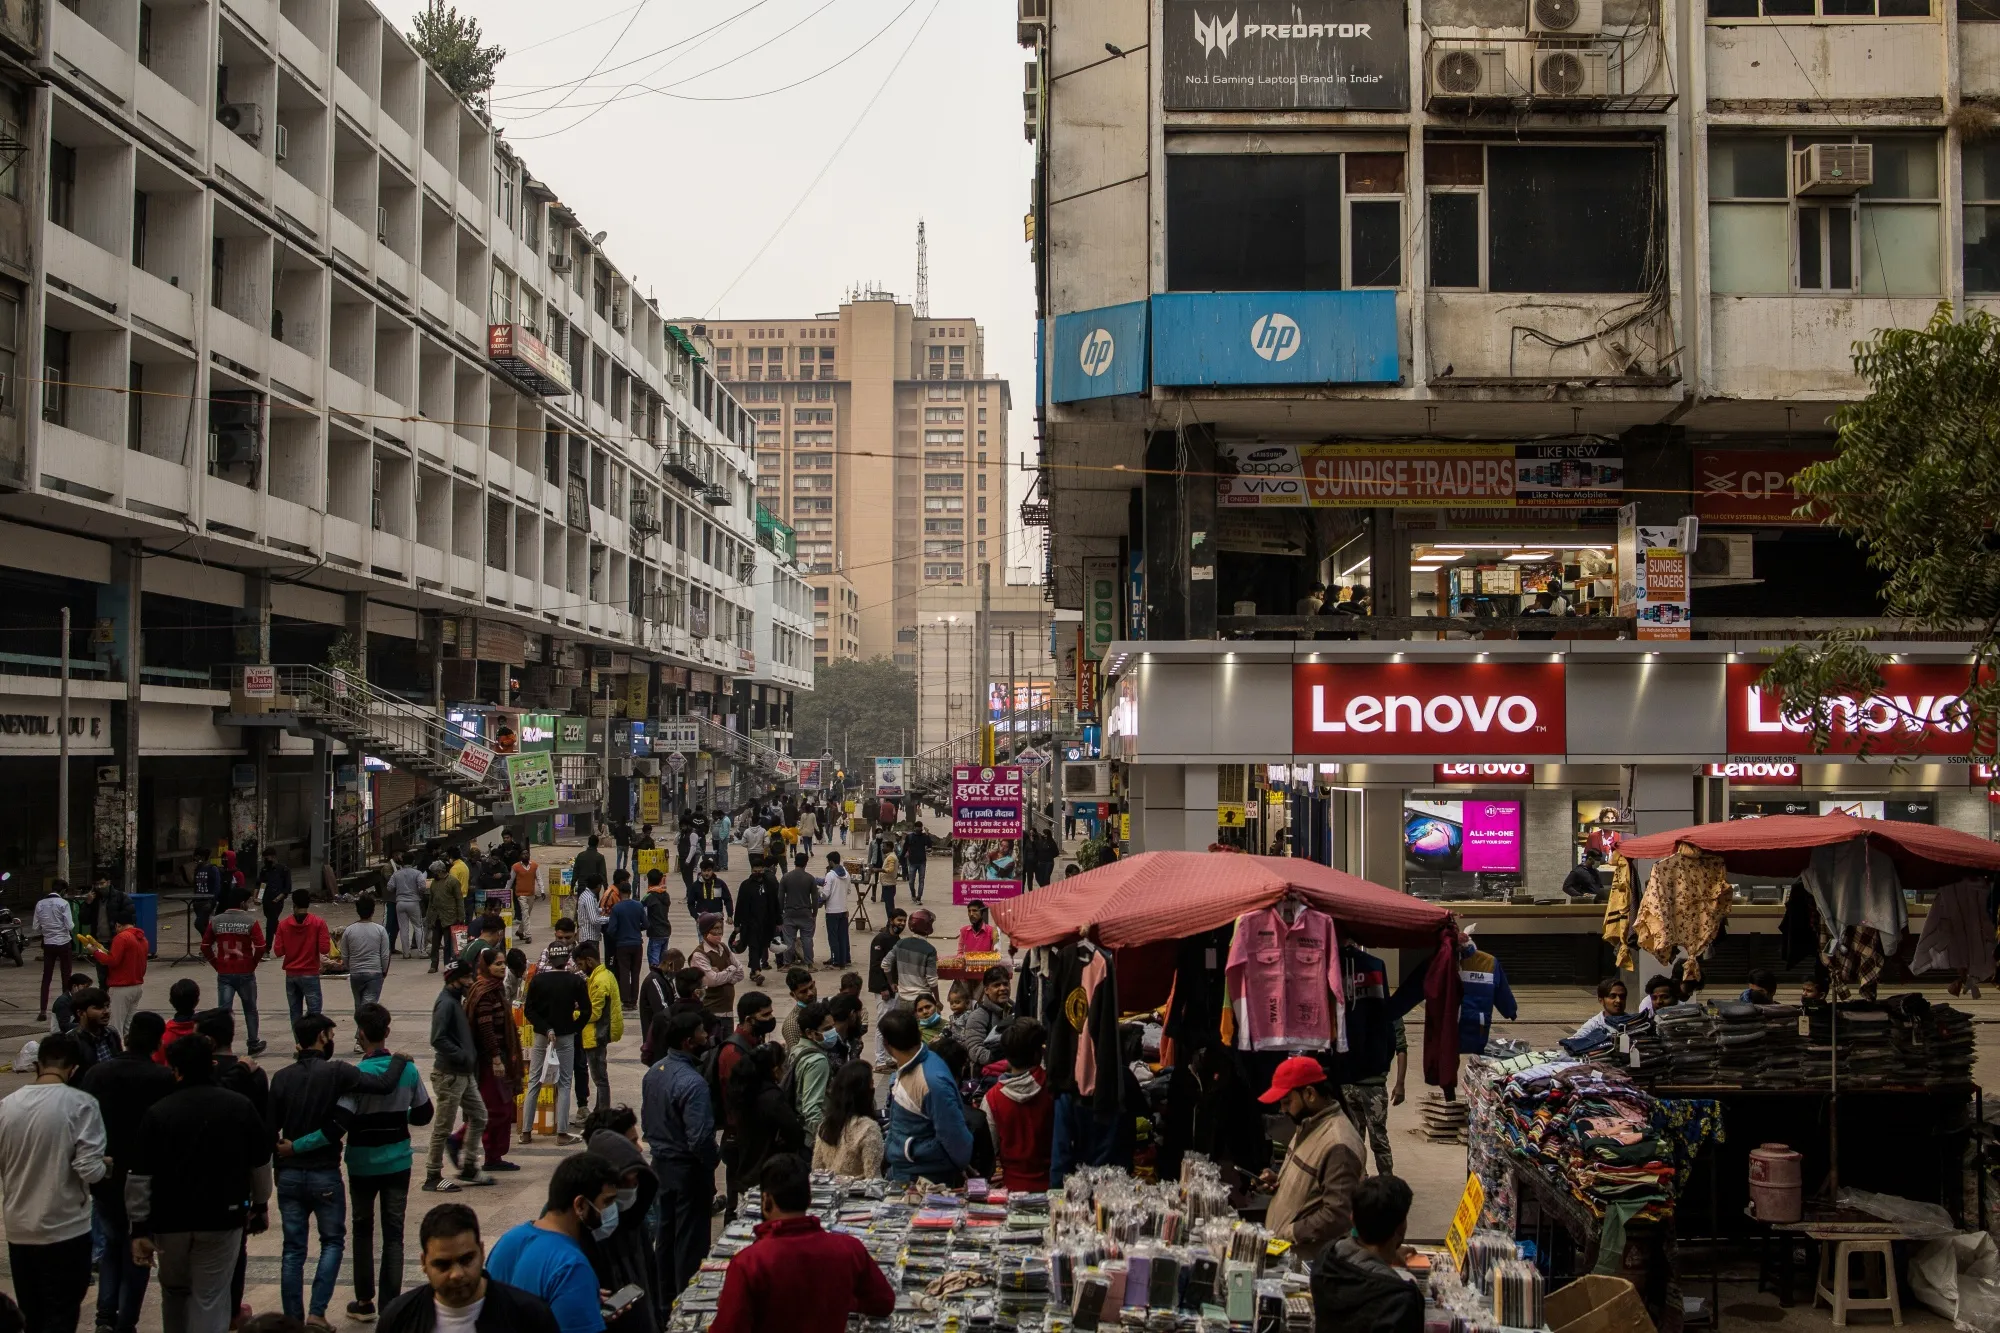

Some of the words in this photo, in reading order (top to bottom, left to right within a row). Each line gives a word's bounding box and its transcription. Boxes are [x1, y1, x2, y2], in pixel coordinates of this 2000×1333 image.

[1244, 23, 1373, 42] PREDATOR
[1186, 75, 1209, 84] No.1
[1213, 75, 1254, 87] Gaming
[1258, 75, 1297, 87] Laptop
[1300, 74, 1334, 85] Brand
[1337, 74, 1347, 85] in
[493, 326, 510, 337] AV
[1252, 313, 1300, 361] hp
[1081, 329, 1114, 376] hp
[1251, 450, 1283, 460] SAMSUNG
[1537, 447, 1562, 458] LIKE
[1564, 446, 1600, 458] NEW
[1315, 459, 1408, 496] SUNRISE
[1411, 458, 1513, 496] TRADERS
[1243, 478, 1298, 492] vivo
[1265, 495, 1298, 503] realme
[1531, 491, 1548, 499] Like
[1551, 491, 1570, 499] New
[1573, 491, 1608, 499] Mobiles
[1719, 513, 1736, 521] CCTV
[1735, 513, 1762, 521] SYSTEMS
[1649, 559, 1683, 573] SUNRISE
[1647, 574, 1685, 588] TRADERS
[249, 668, 270, 676] Xpert
[252, 676, 272, 684] Data
[1312, 685, 1537, 733] Lenovo
[1746, 684, 1973, 734] Lenovo
[468, 745, 489, 759] Xpert
[1068, 749, 1080, 761] hp
[461, 758, 485, 773] Recovery
[467, 755, 487, 769] Data
[1443, 763, 1525, 775] Lenovo
[1712, 763, 1795, 777] Lenovo
[955, 783, 991, 801] हुनर
[994, 783, 1020, 797] हाट
[974, 808, 994, 818] प्रगति
[994, 808, 1015, 818] मैदान
[1269, 997, 1278, 1023] SWAG
